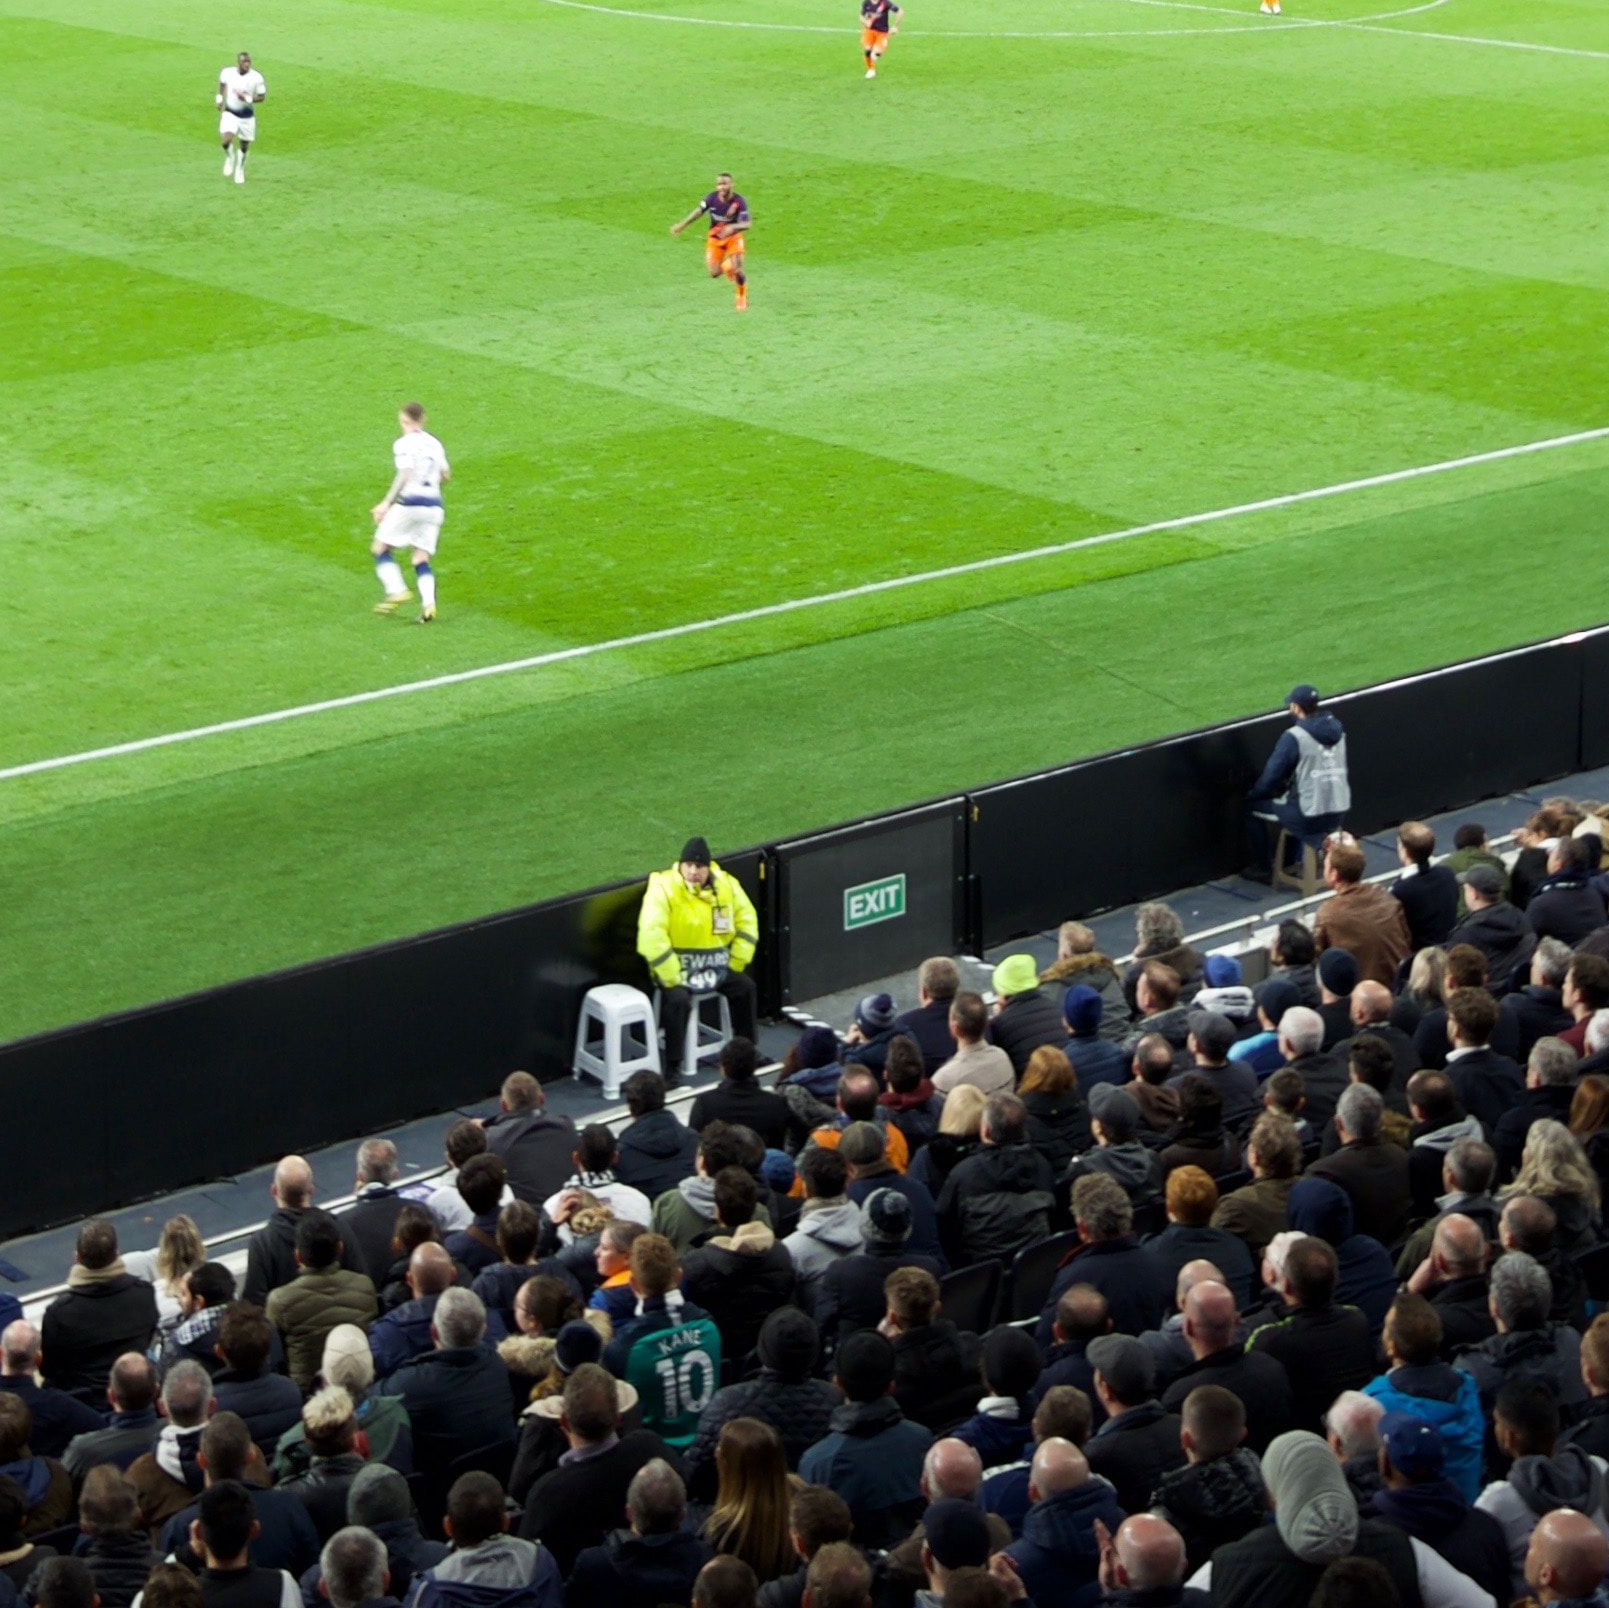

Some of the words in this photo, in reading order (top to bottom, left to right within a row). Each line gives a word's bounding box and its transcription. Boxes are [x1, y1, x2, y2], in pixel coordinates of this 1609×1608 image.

[850, 883, 900, 920] EXIT
[657, 1328, 702, 1357] KANE
[655, 1349, 714, 1418] 10
